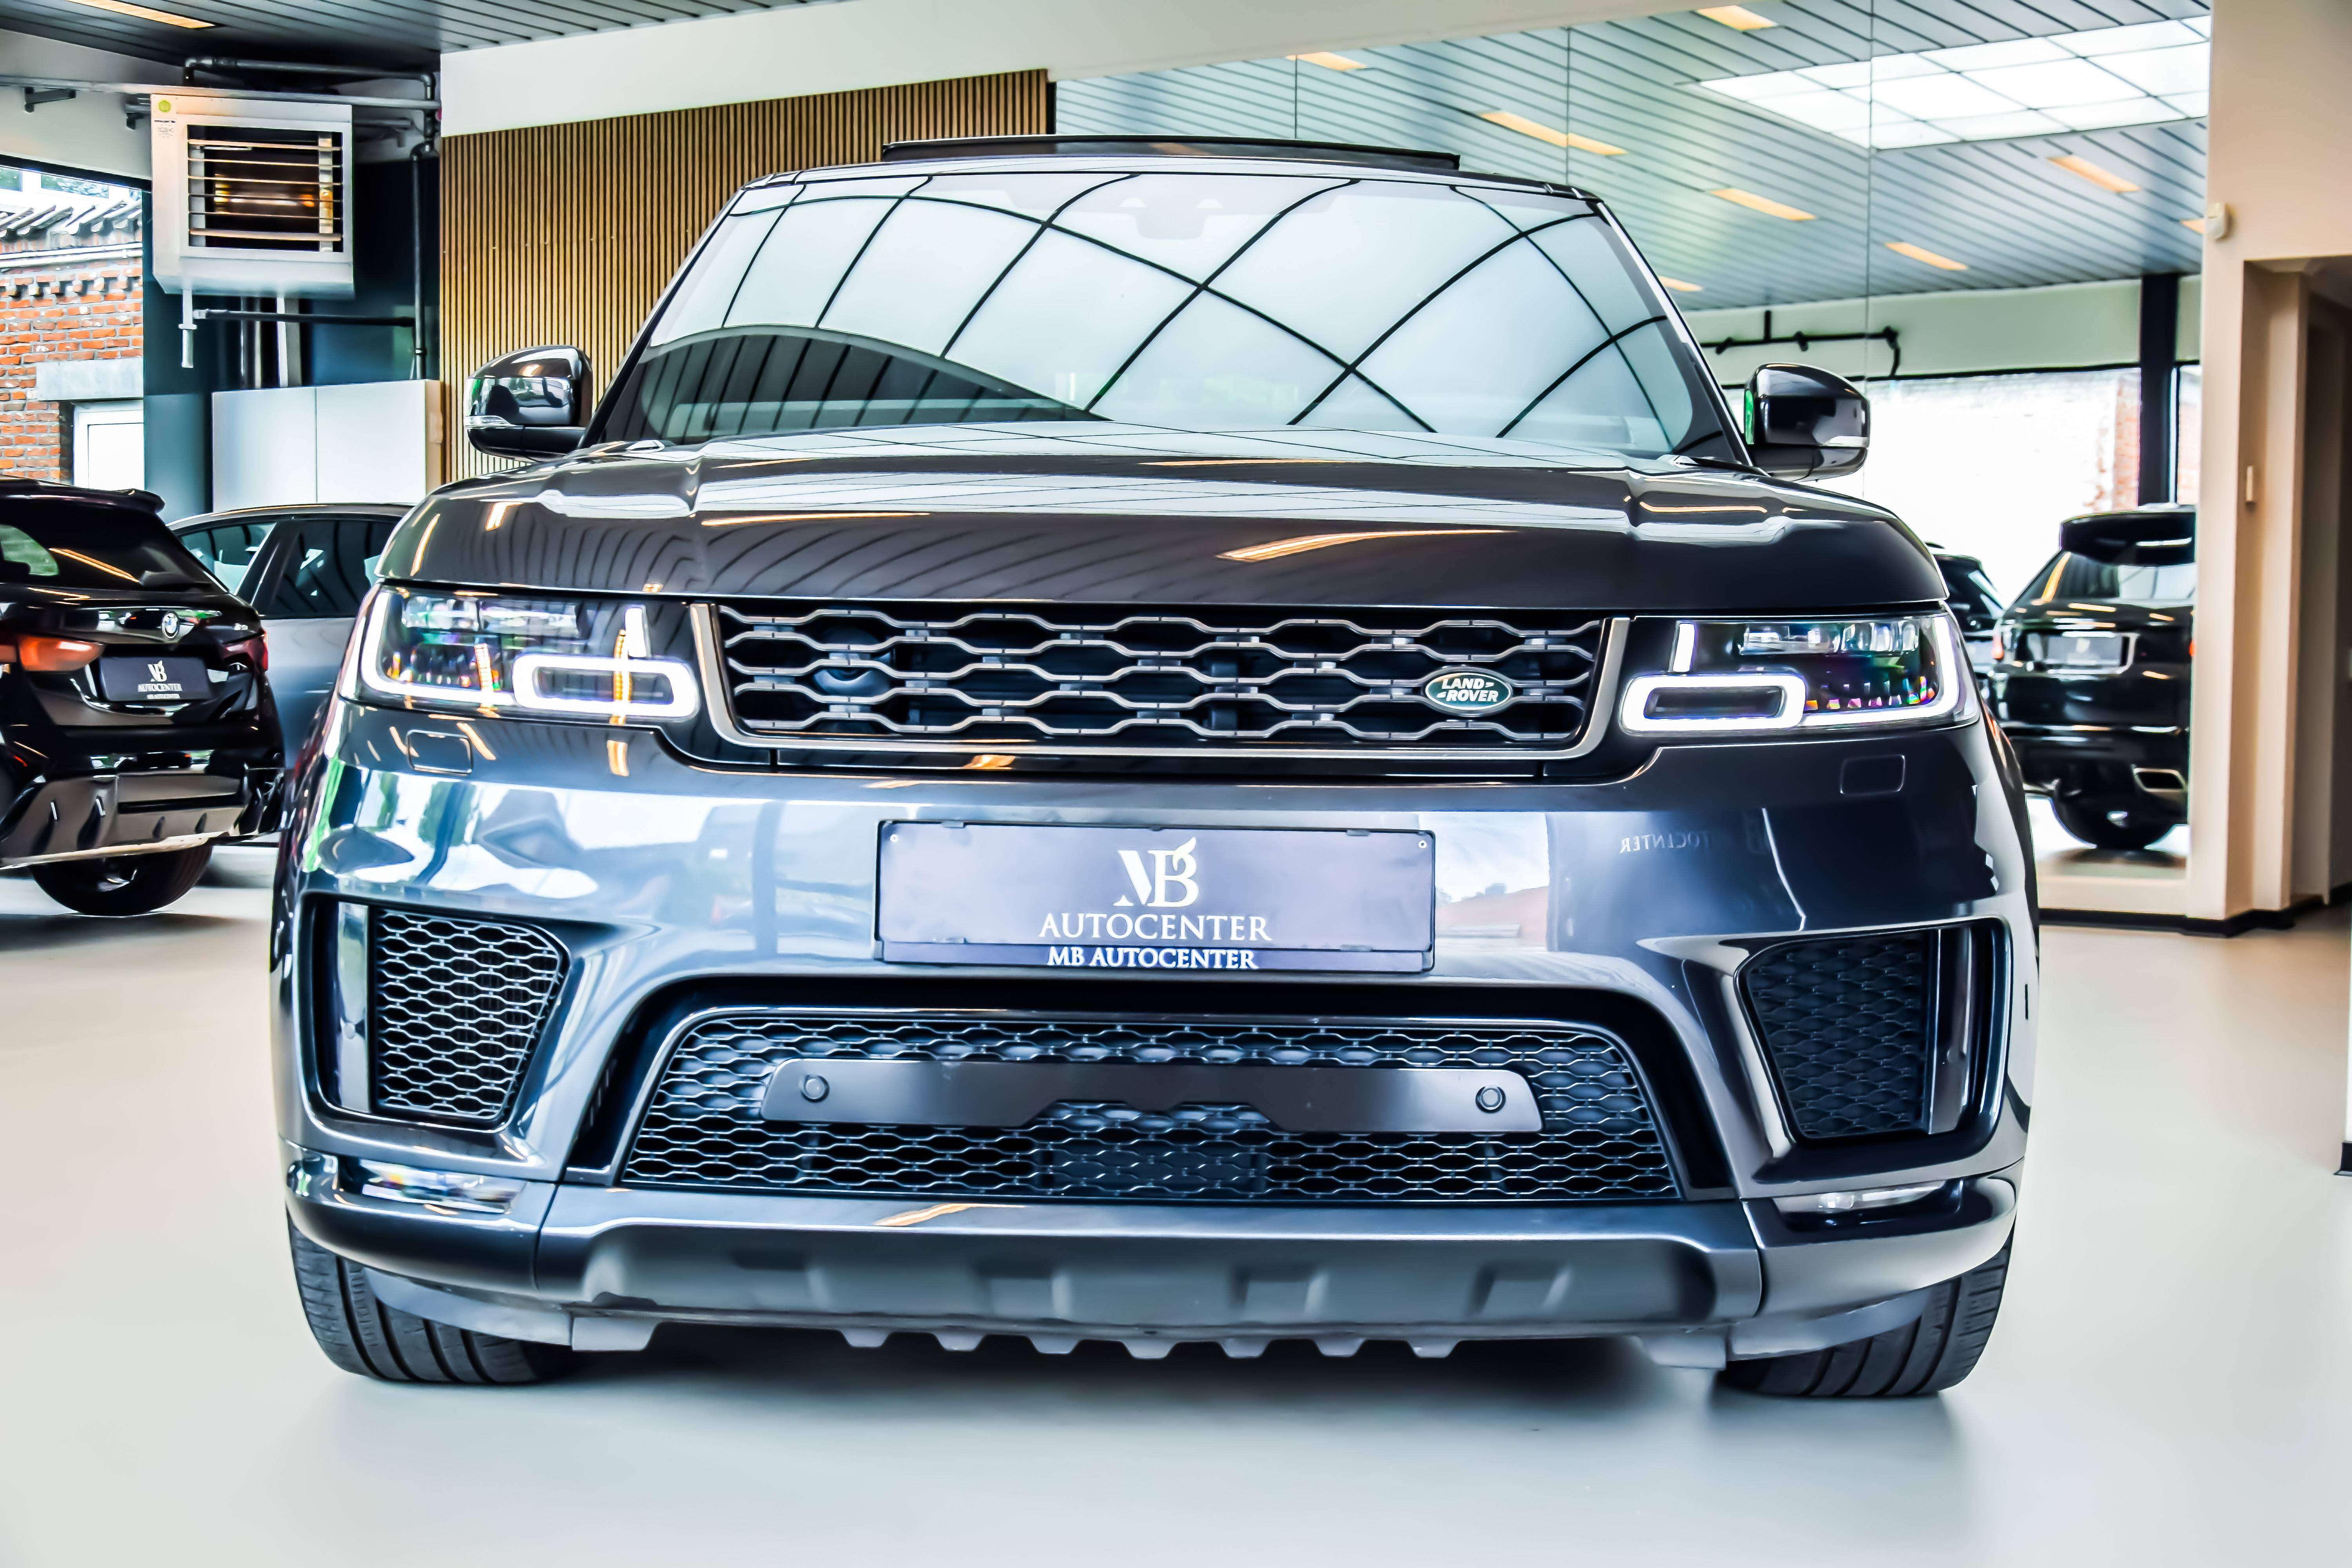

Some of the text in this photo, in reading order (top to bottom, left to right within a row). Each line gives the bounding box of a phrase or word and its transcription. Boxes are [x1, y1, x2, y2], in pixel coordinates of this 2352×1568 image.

[1441, 678, 1485, 690] LAND
[1446, 689, 1499, 702] ROVER
[1038, 912, 1273, 942] AUTOCENTER
[1046, 946, 1259, 969] MB AUTOCENTER
